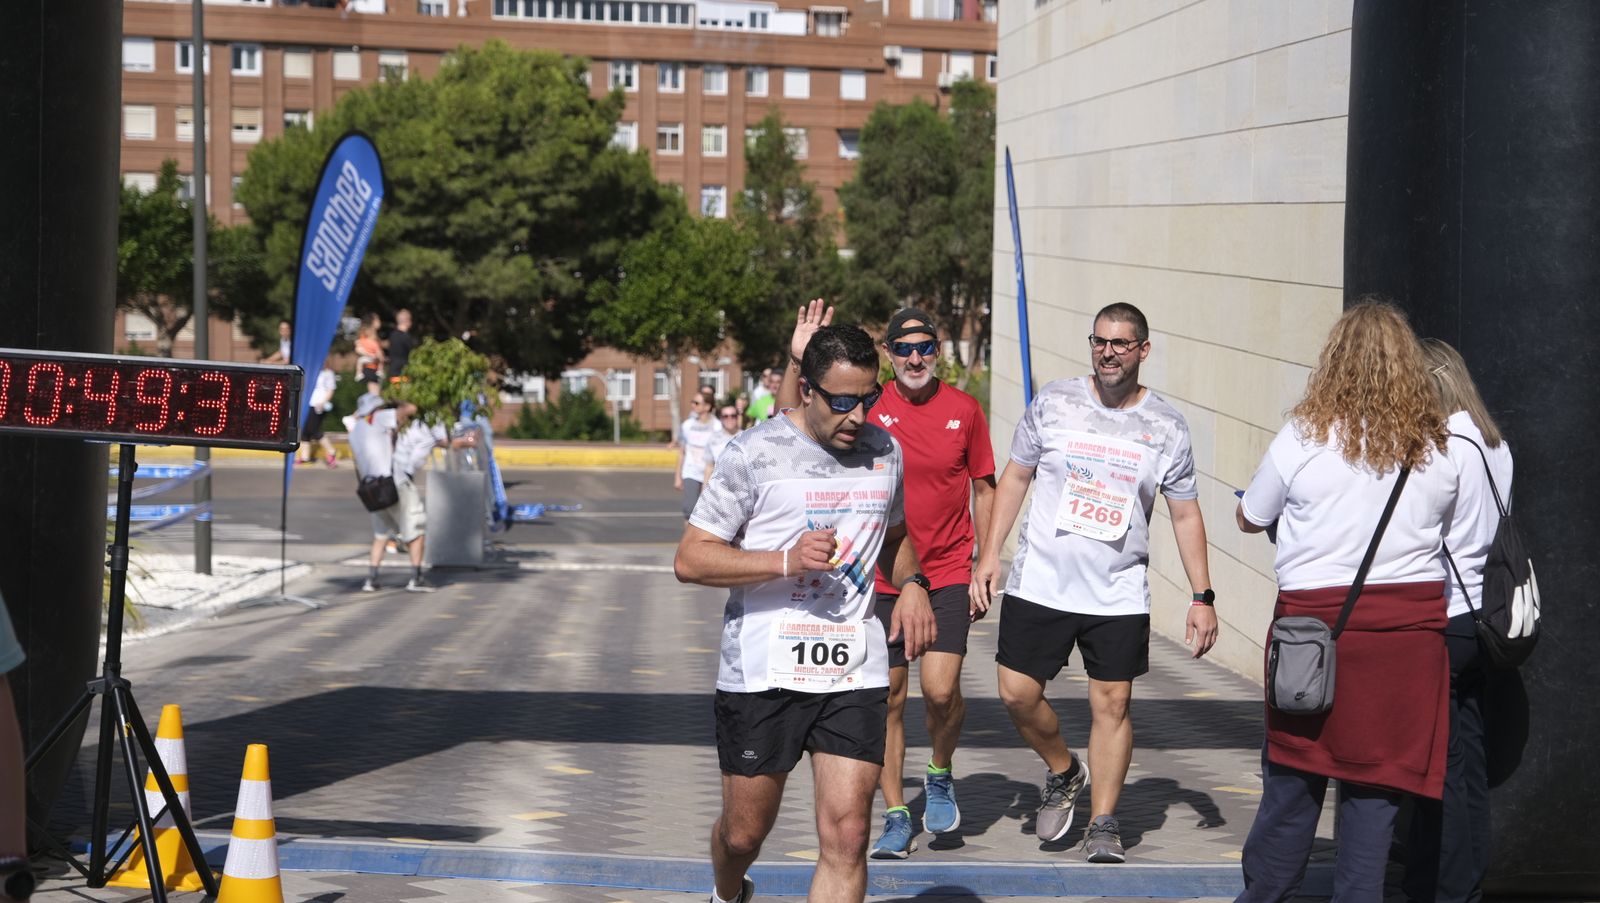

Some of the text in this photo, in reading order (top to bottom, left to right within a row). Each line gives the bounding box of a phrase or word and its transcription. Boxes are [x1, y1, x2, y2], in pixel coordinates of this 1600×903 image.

[0, 360, 283, 435] 0:49:34
[1074, 441, 1106, 454] CARRERA
[1107, 446, 1121, 457] SIN
[1122, 449, 1142, 461] HUMO
[815, 491, 850, 502] CARRERA
[853, 490, 869, 500] SIN
[1069, 498, 1122, 526] 1269
[786, 623, 821, 633] CARRERA
[822, 624, 835, 633] SIN
[836, 625, 856, 633] HUMO
[791, 641, 849, 666] 106
[794, 666, 845, 675] MIGUEL ZAPATA
